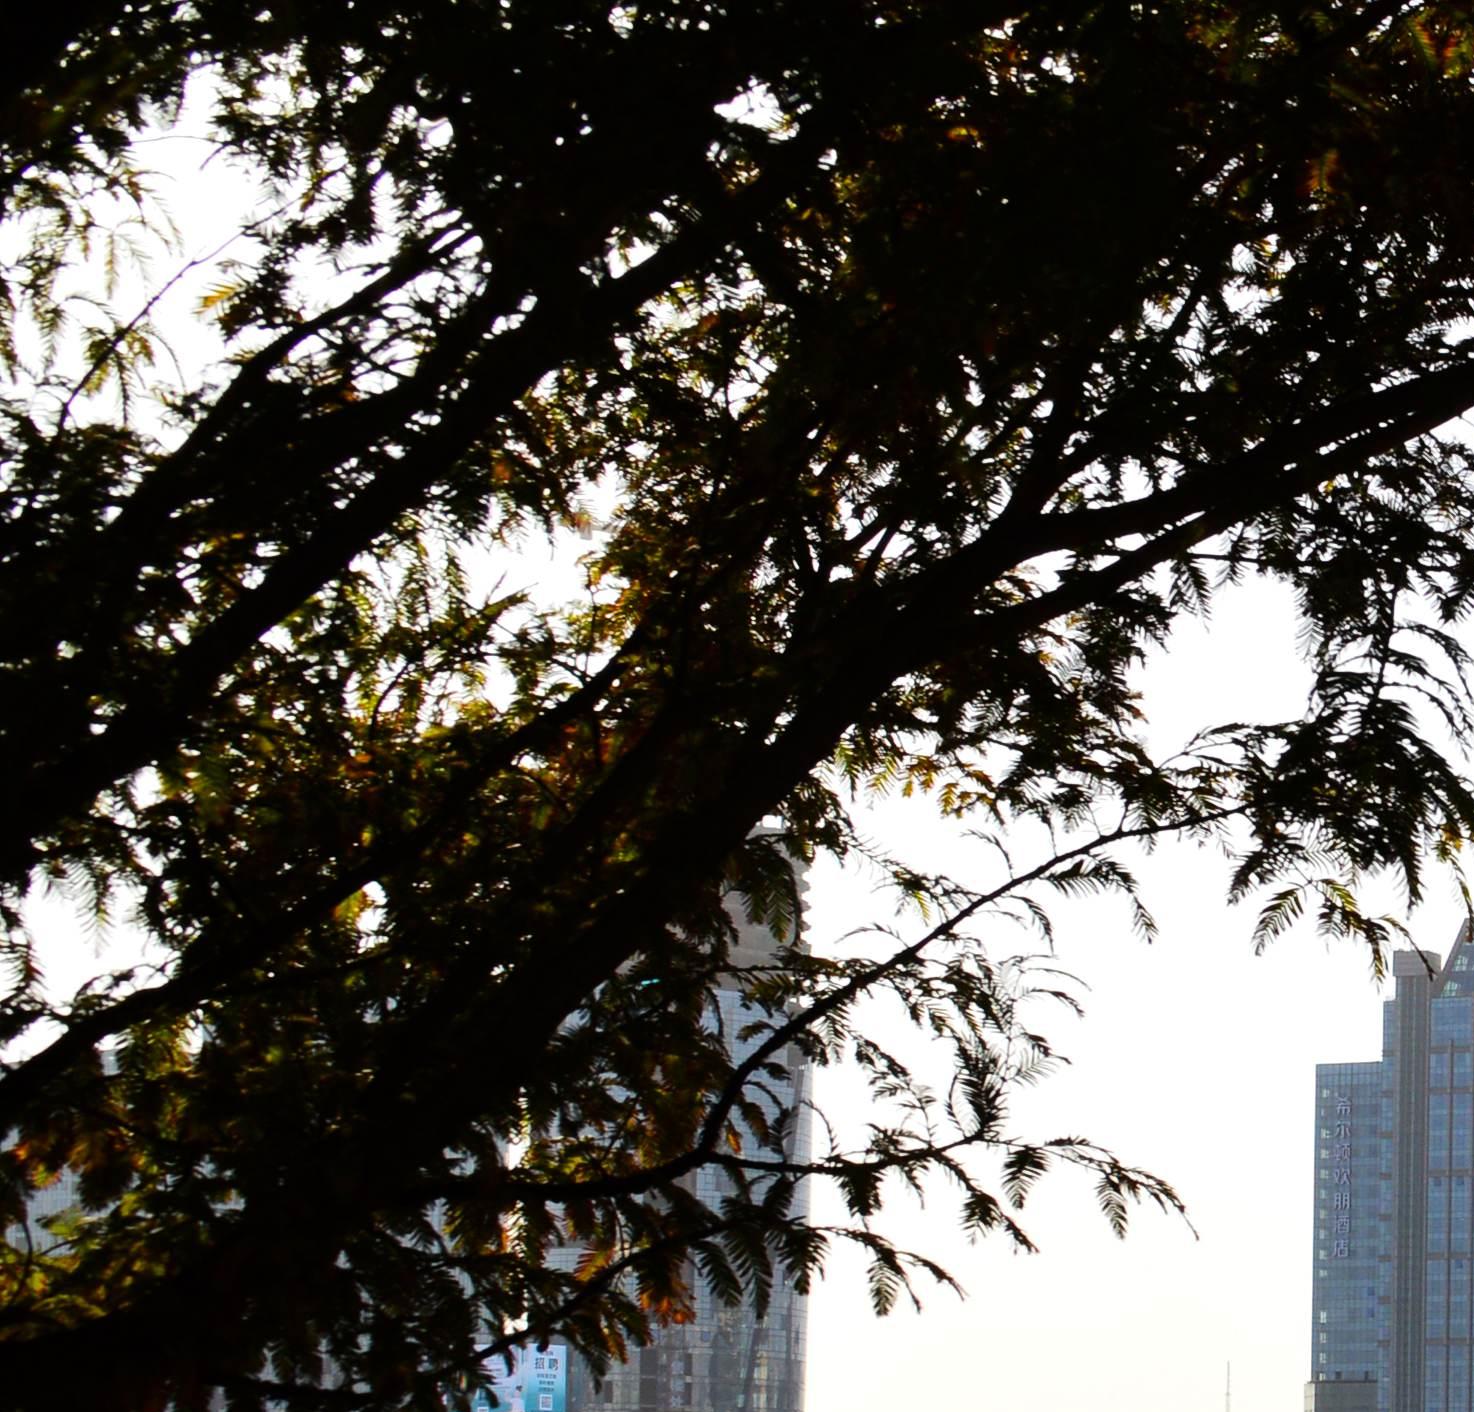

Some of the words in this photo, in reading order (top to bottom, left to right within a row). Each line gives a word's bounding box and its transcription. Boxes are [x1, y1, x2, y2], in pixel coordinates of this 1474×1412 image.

[1332, 1096, 1351, 1257] 希尔顿欢朋酒店
[535, 1357, 559, 1371] 招聘
